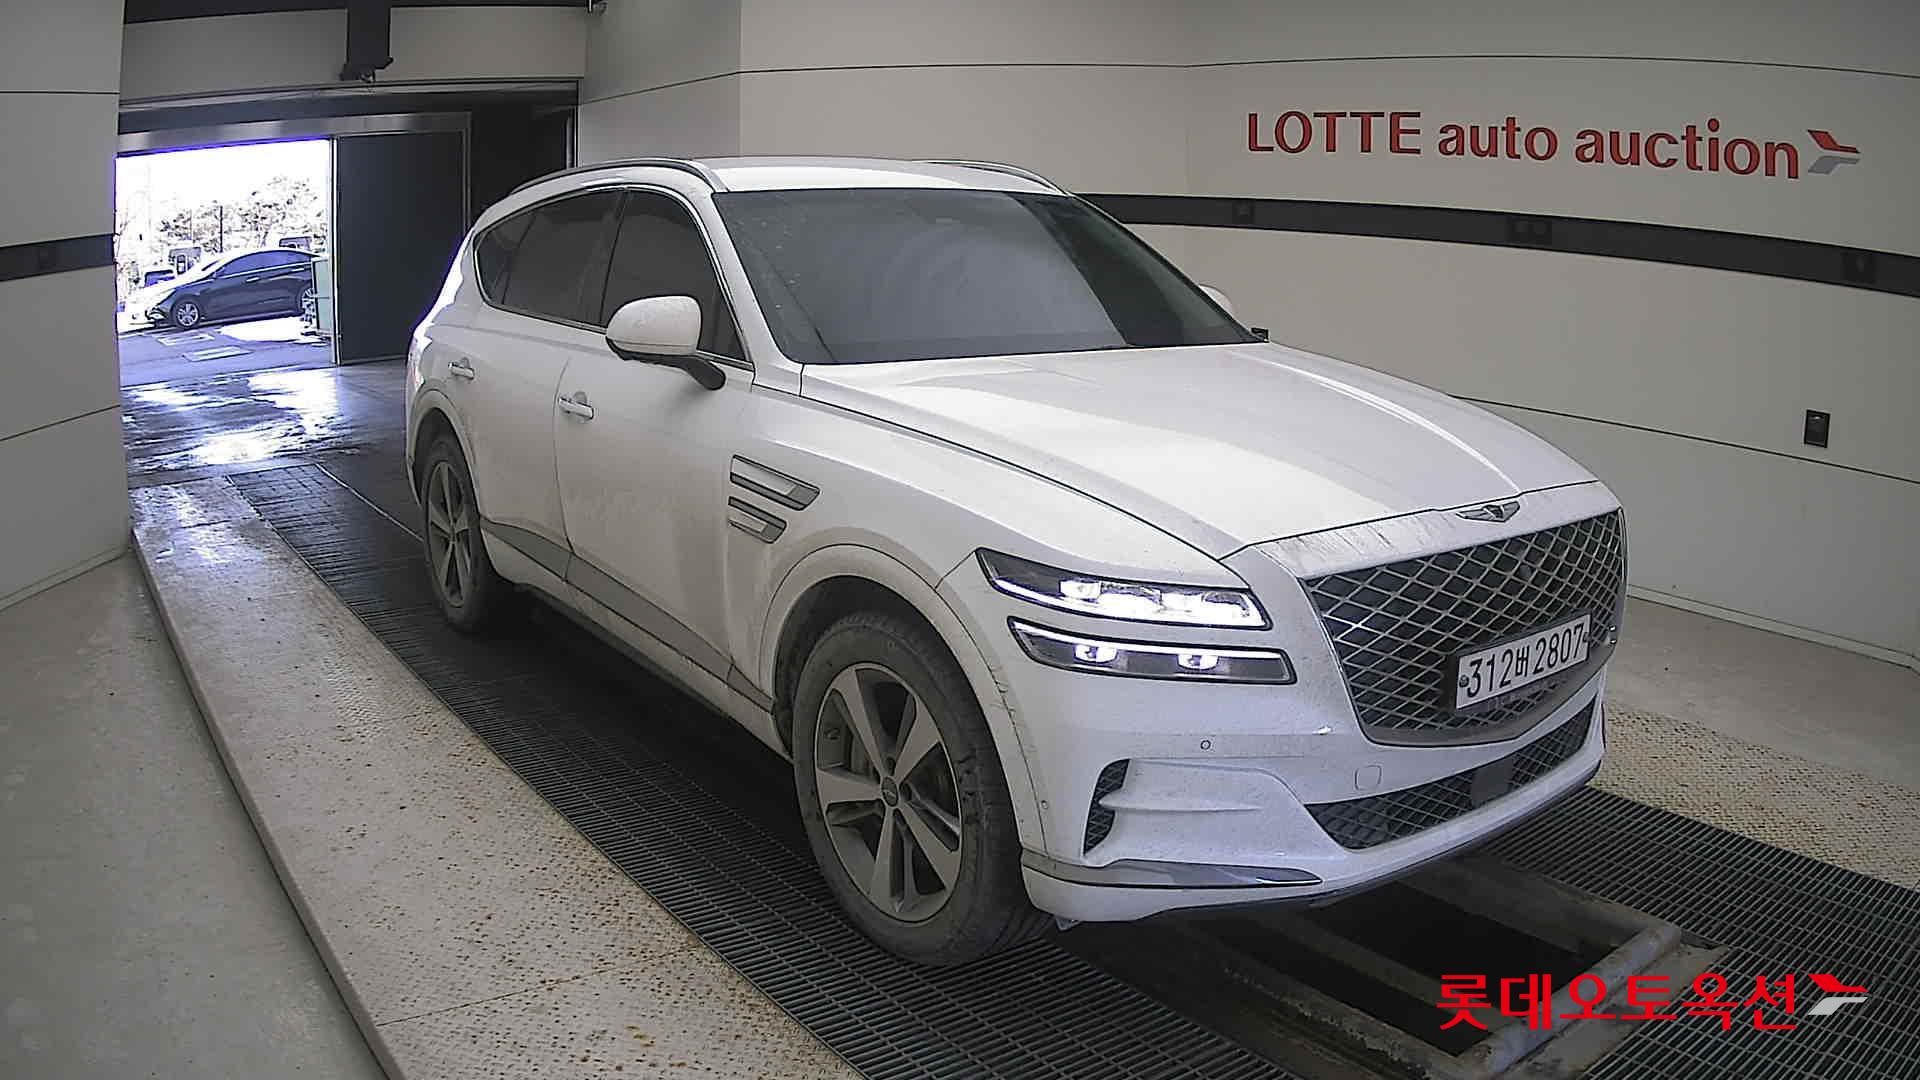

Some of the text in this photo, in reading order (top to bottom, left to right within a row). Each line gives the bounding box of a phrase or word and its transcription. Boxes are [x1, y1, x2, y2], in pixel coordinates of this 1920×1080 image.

[1247, 111, 1800, 180] LOTTE auto auction
